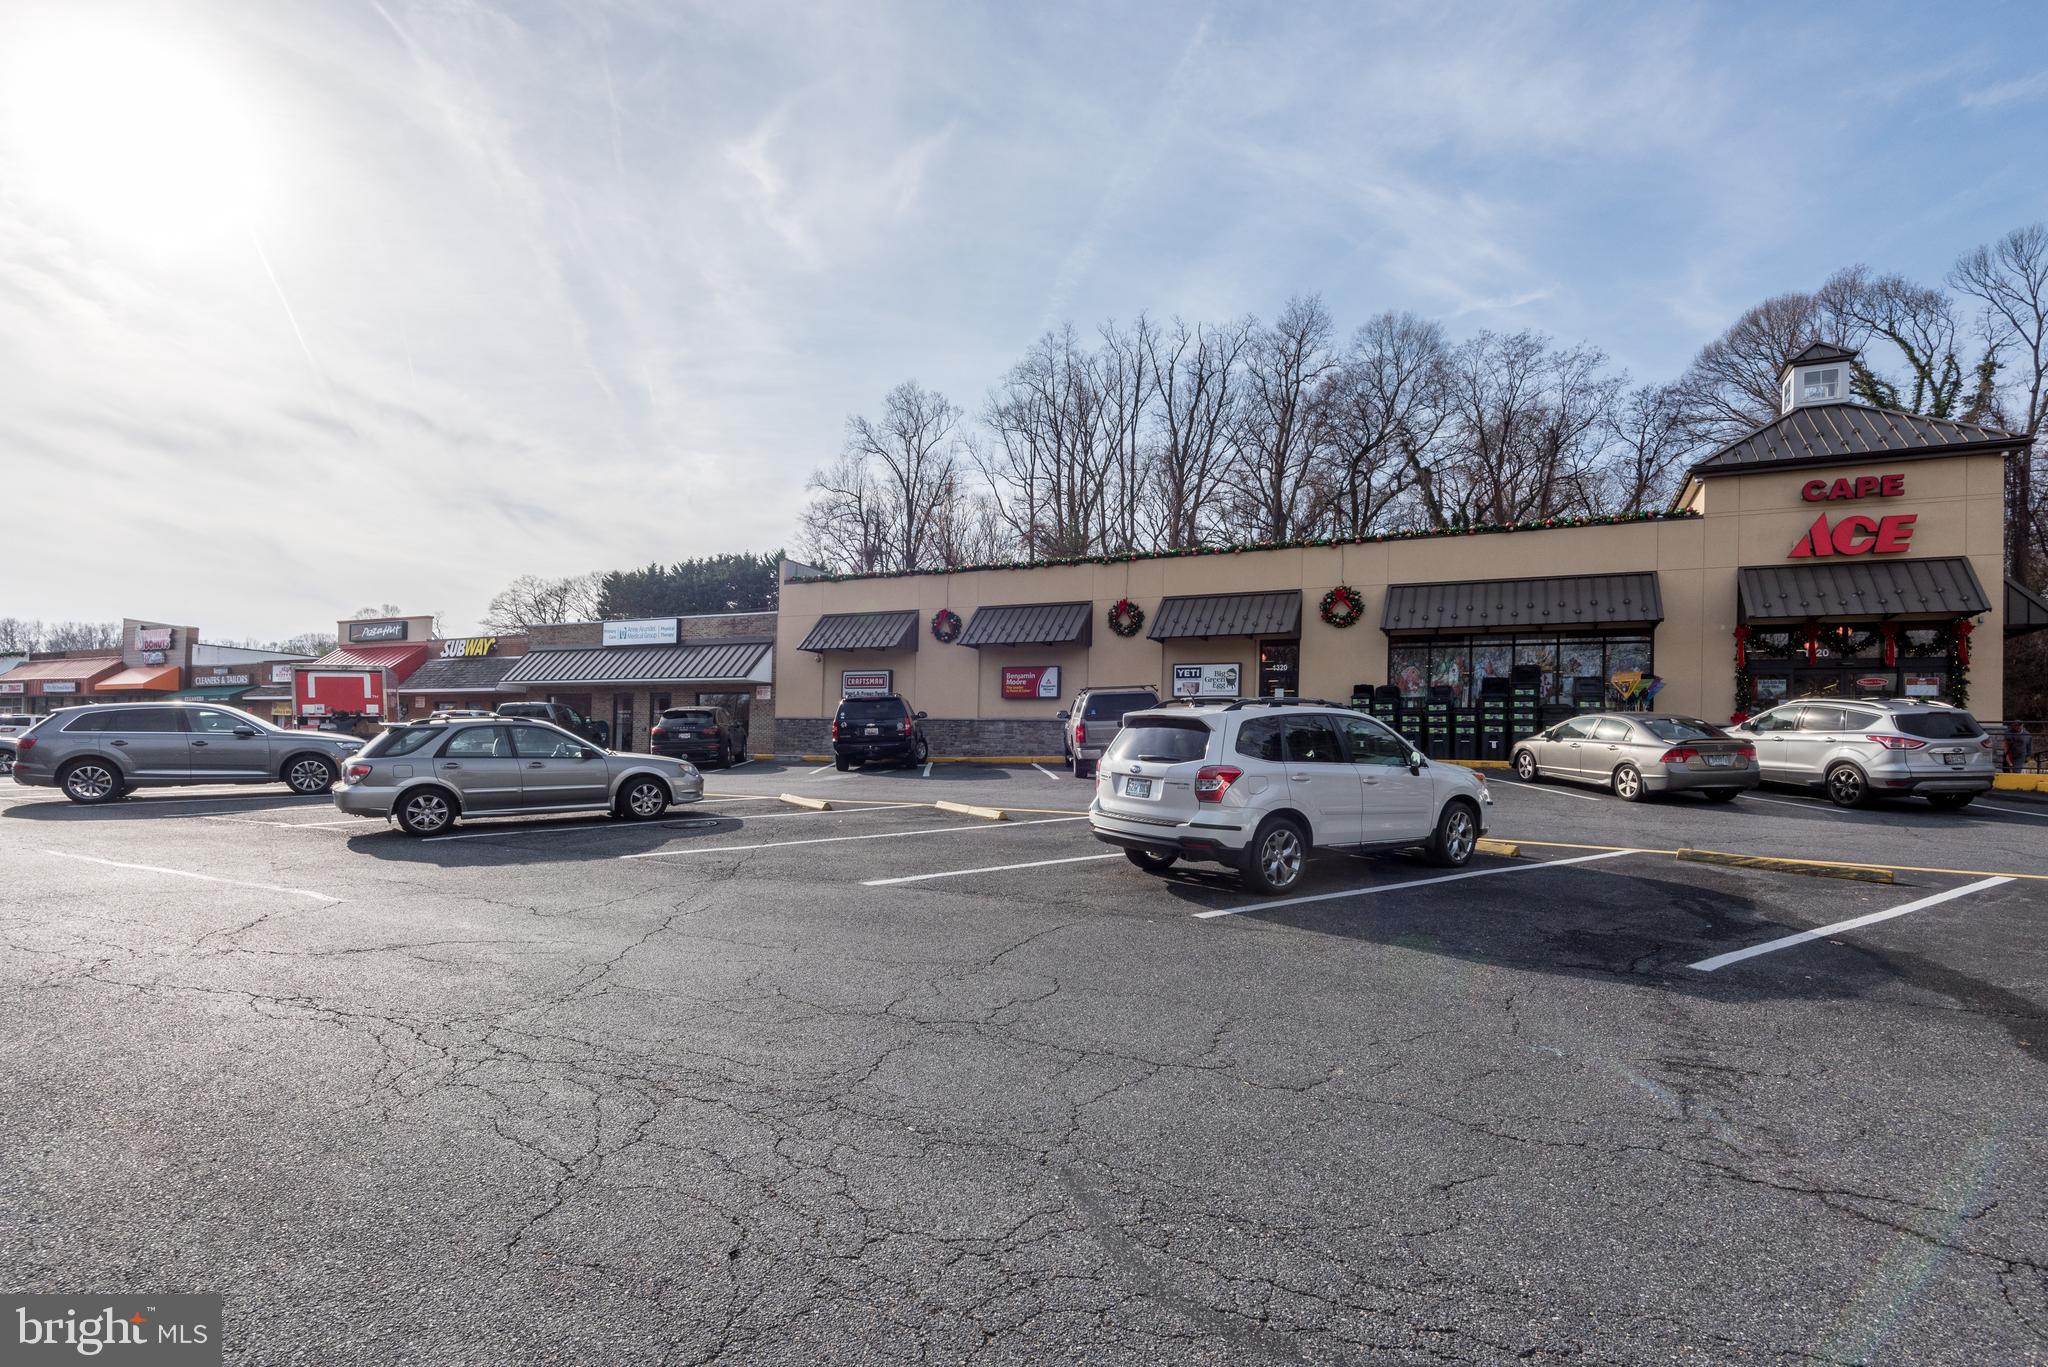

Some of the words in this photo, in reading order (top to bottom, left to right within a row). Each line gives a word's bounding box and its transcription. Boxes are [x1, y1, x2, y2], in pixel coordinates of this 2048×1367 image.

[1801, 474, 1905, 502] CAPE
[1787, 512, 1918, 558] ACE
[144, 640, 170, 650] DONUTS
[440, 638, 496, 658] SUBWAY
[1803, 648, 1830, 657] 120
[1006, 672, 1036, 680] Benjamin
[1177, 669, 1200, 677] YETI
[1214, 670, 1226, 678] Big
[195, 676, 220, 686] CLEANERS
[220, 676, 226, 684] &
[226, 674, 248, 684] TAILORS
[1212, 682, 1226, 690] Egg
